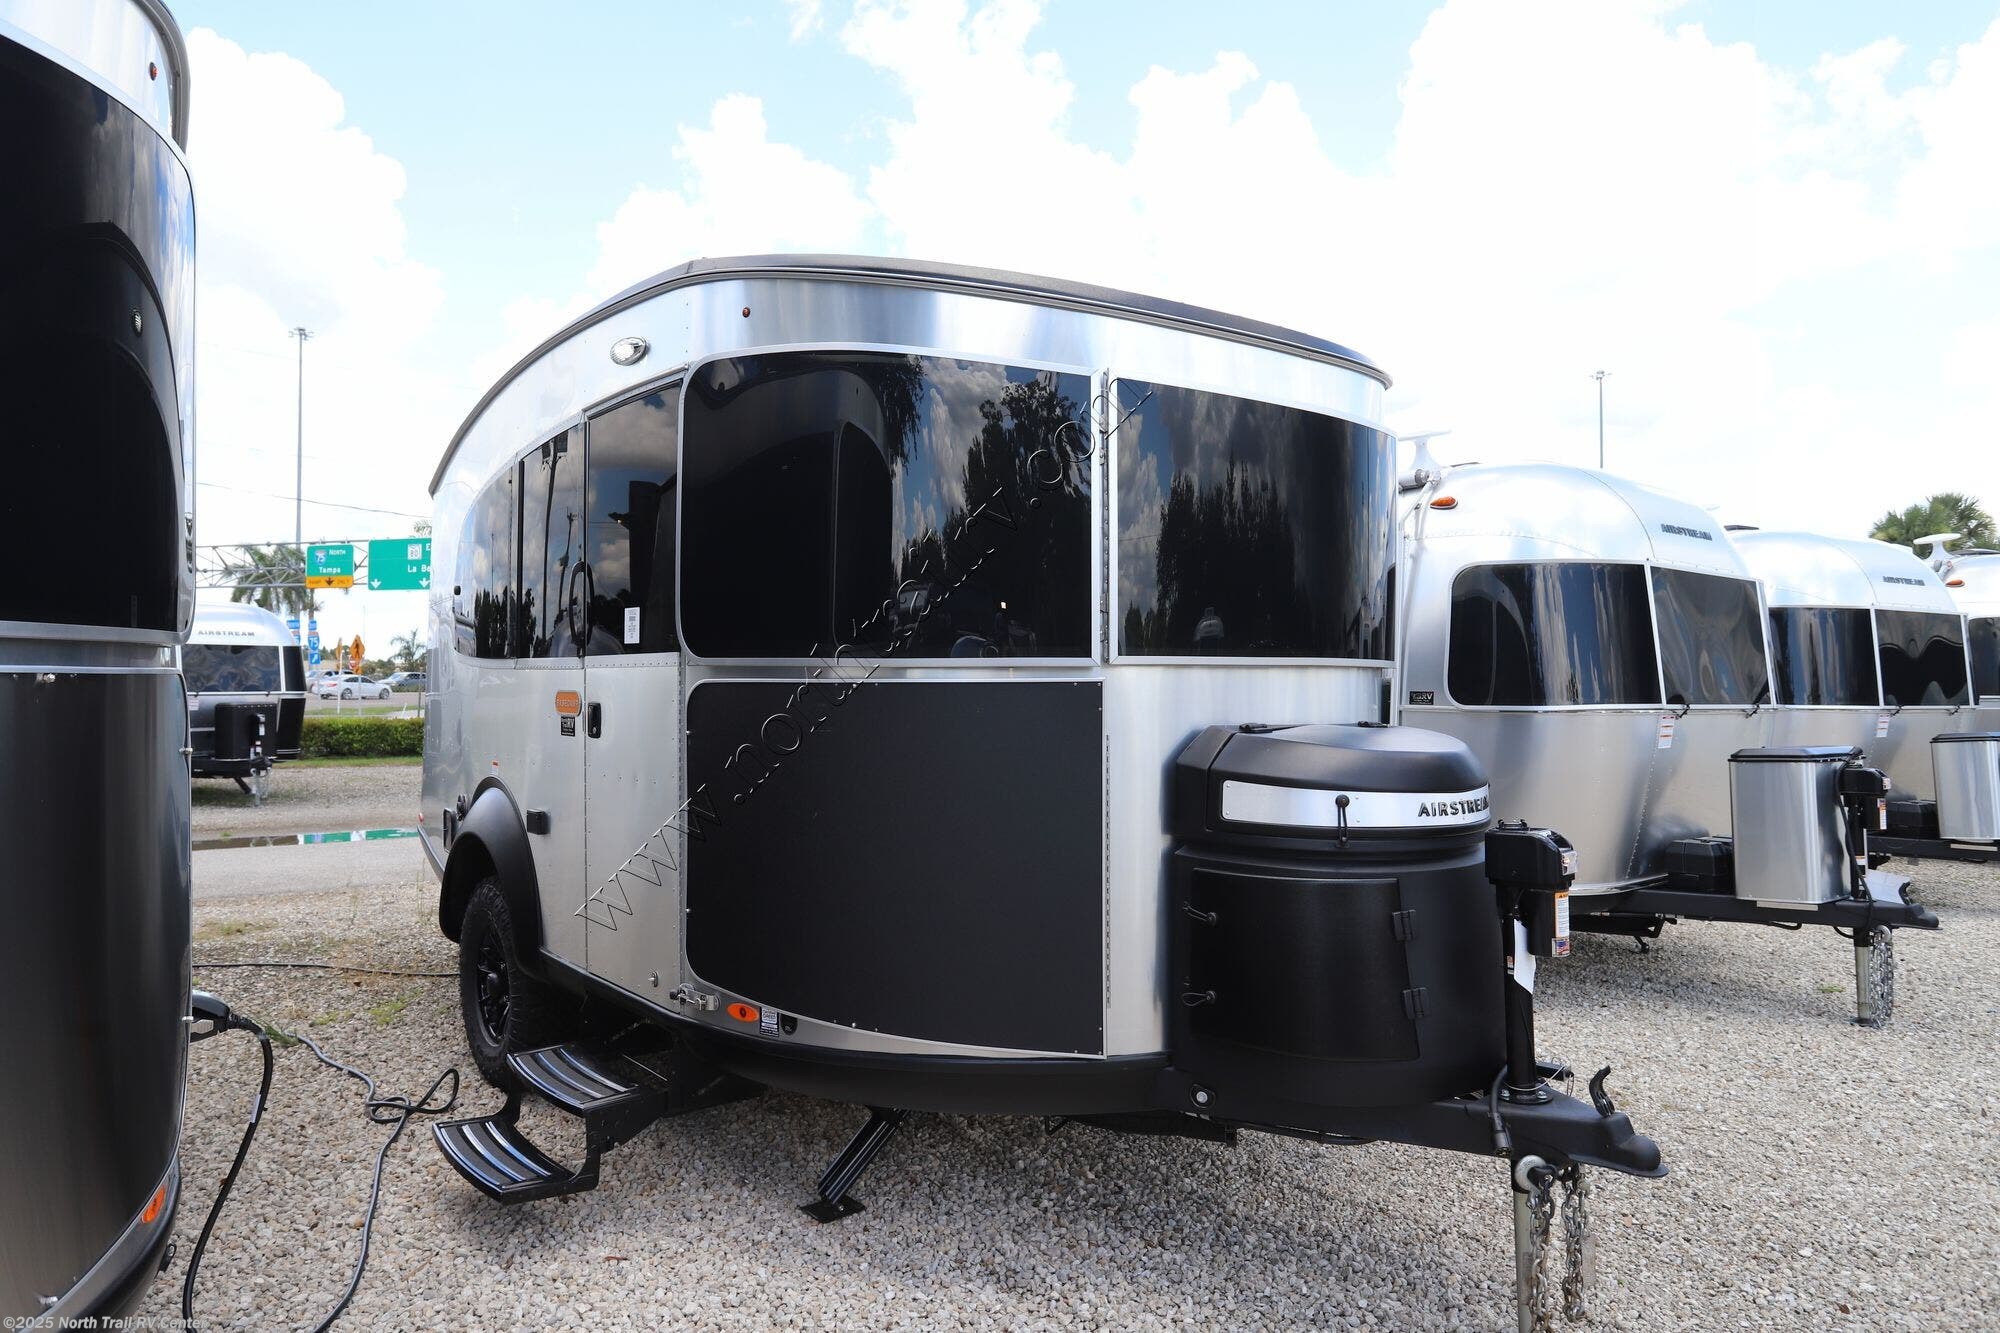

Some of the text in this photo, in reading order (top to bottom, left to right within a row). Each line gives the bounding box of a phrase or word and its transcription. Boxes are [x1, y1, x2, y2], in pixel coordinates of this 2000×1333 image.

[1661, 524, 1712, 541] AIRSTREAM
[318, 566, 341, 574] Tampa
[407, 564, 417, 573] La
[309, 637, 318, 648] 75
